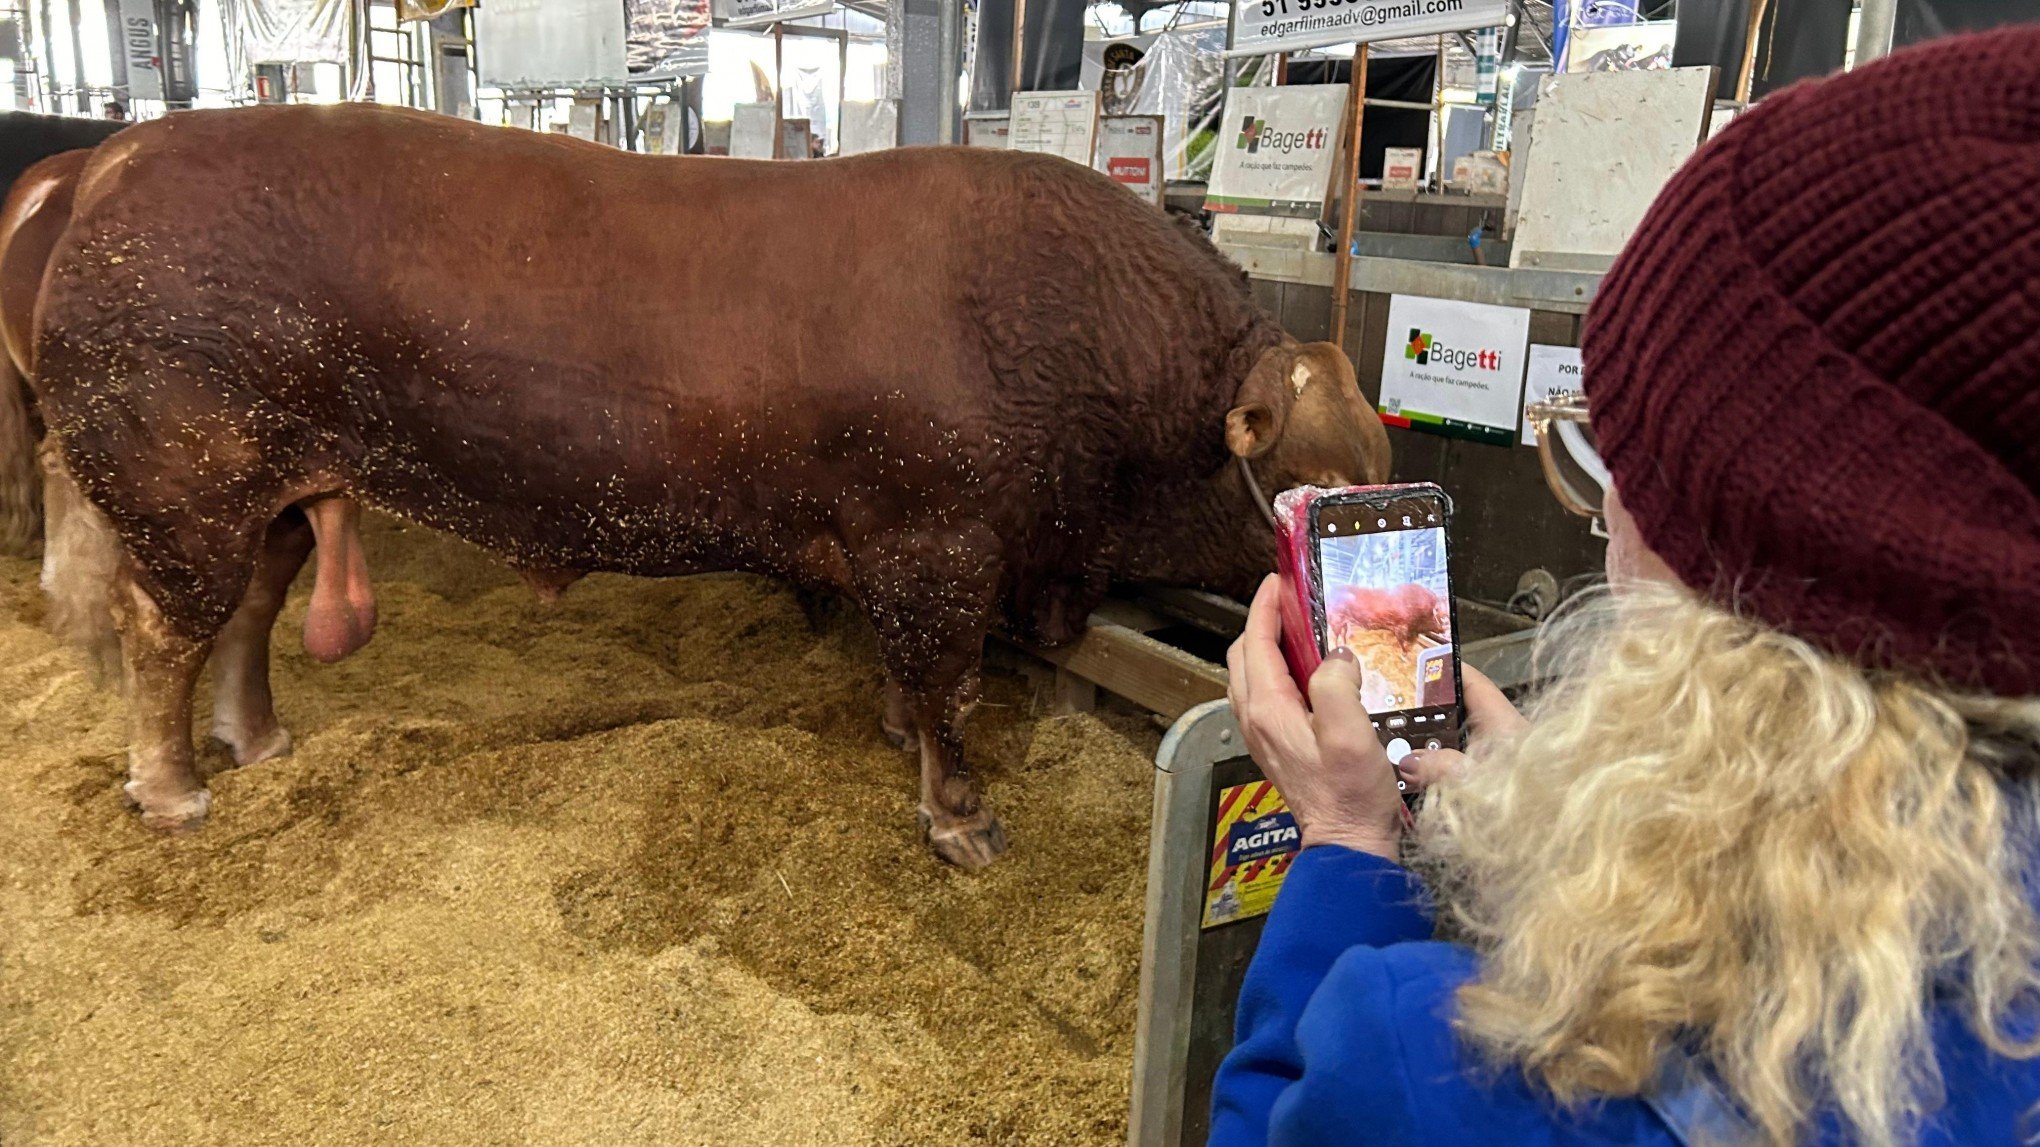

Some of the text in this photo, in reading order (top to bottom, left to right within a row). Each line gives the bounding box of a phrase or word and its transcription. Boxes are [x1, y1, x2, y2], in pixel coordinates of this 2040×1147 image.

[127, 17, 153, 70] ANGUS
[1261, 127, 1329, 154] Bagetti
[1272, 161, 1281, 169] faz
[1430, 342, 1502, 371] Bagetti
[1558, 364, 1579, 375] POR
[1415, 373, 1431, 381] ração
[1432, 375, 1444, 383] que
[1445, 376, 1454, 384] faz
[1231, 826, 1299, 853] AGITA
